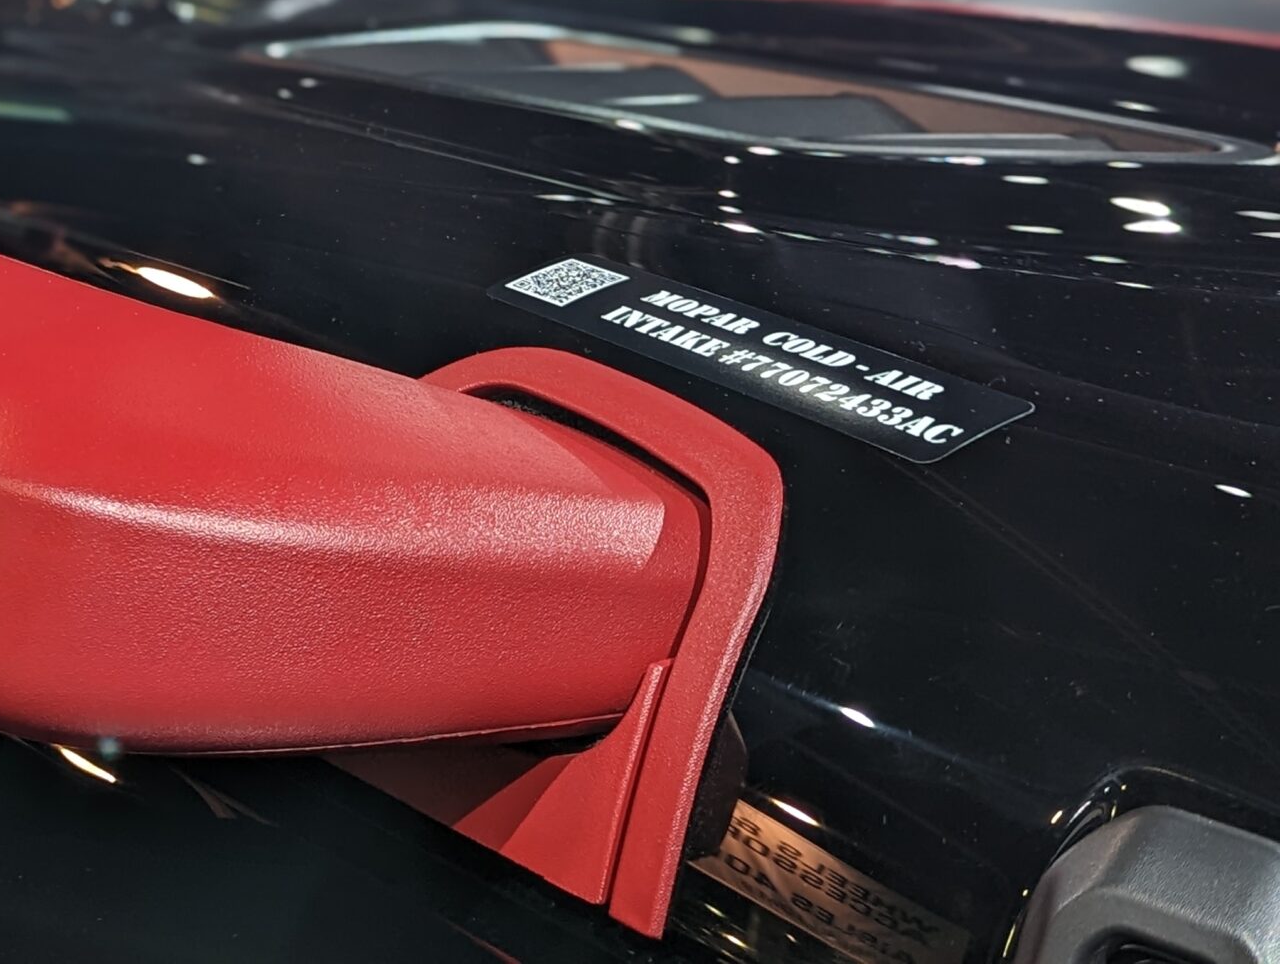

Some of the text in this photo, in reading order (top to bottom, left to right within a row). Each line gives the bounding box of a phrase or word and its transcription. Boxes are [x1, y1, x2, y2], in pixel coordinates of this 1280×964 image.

[640, 290, 761, 335] MOPAR
[600, 305, 964, 444] INTAKE #77072433AC
